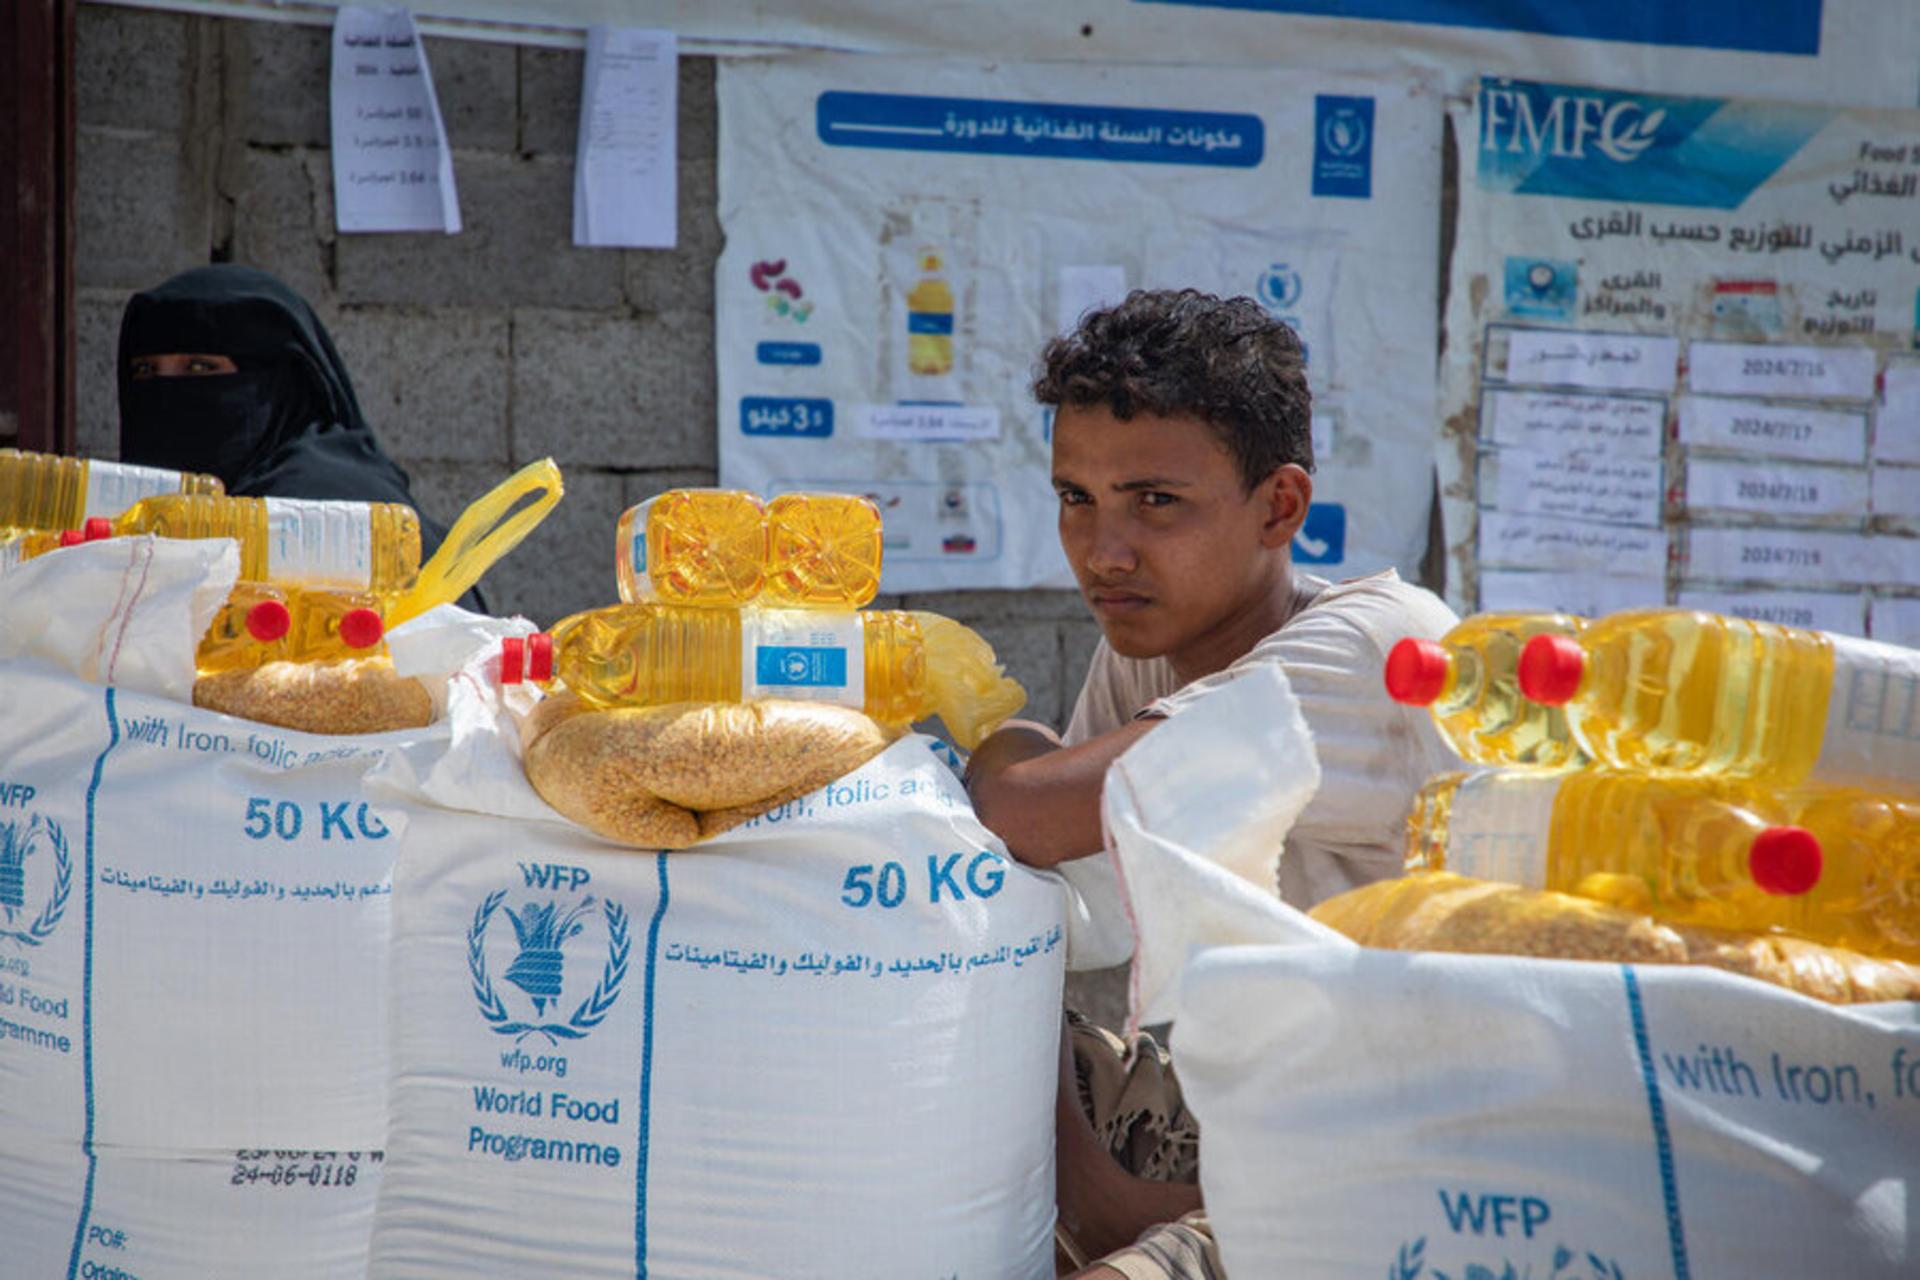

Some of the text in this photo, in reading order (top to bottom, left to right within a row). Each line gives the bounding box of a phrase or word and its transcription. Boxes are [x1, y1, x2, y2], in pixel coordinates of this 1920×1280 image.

[1012, 116, 1095, 144] الغذائية
[1099, 118, 1162, 144] السلة
[1167, 125, 1242, 151] مكونات
[1570, 208, 1642, 240] القرى
[1650, 221, 1722, 246] حسب
[1819, 228, 1903, 264] الزمني
[124, 716, 169, 748] with
[247, 732, 298, 769] folic
[826, 779, 889, 808] folic
[245, 797, 301, 840] 50
[101, 866, 204, 899] والفيتامينات
[208, 880, 285, 900] والفوليك
[291, 880, 356, 900] بالحديد
[517, 861, 591, 892] WFP
[841, 850, 1007, 909] 50 KG
[664, 942, 788, 976] والفيتامينات
[791, 952, 882, 978] والفوليك
[889, 952, 962, 978] بالحديد
[20, 986, 69, 1019] Food
[500, 1050, 568, 1078] wfp.org
[1663, 1044, 1761, 1100] with
[1771, 1053, 1876, 1110] Iron,
[473, 1085, 620, 1125] World Food
[468, 1125, 621, 1168] Programme
[231, 1164, 358, 1187] 24-06-0118
[1438, 1188, 1552, 1239] WFP
